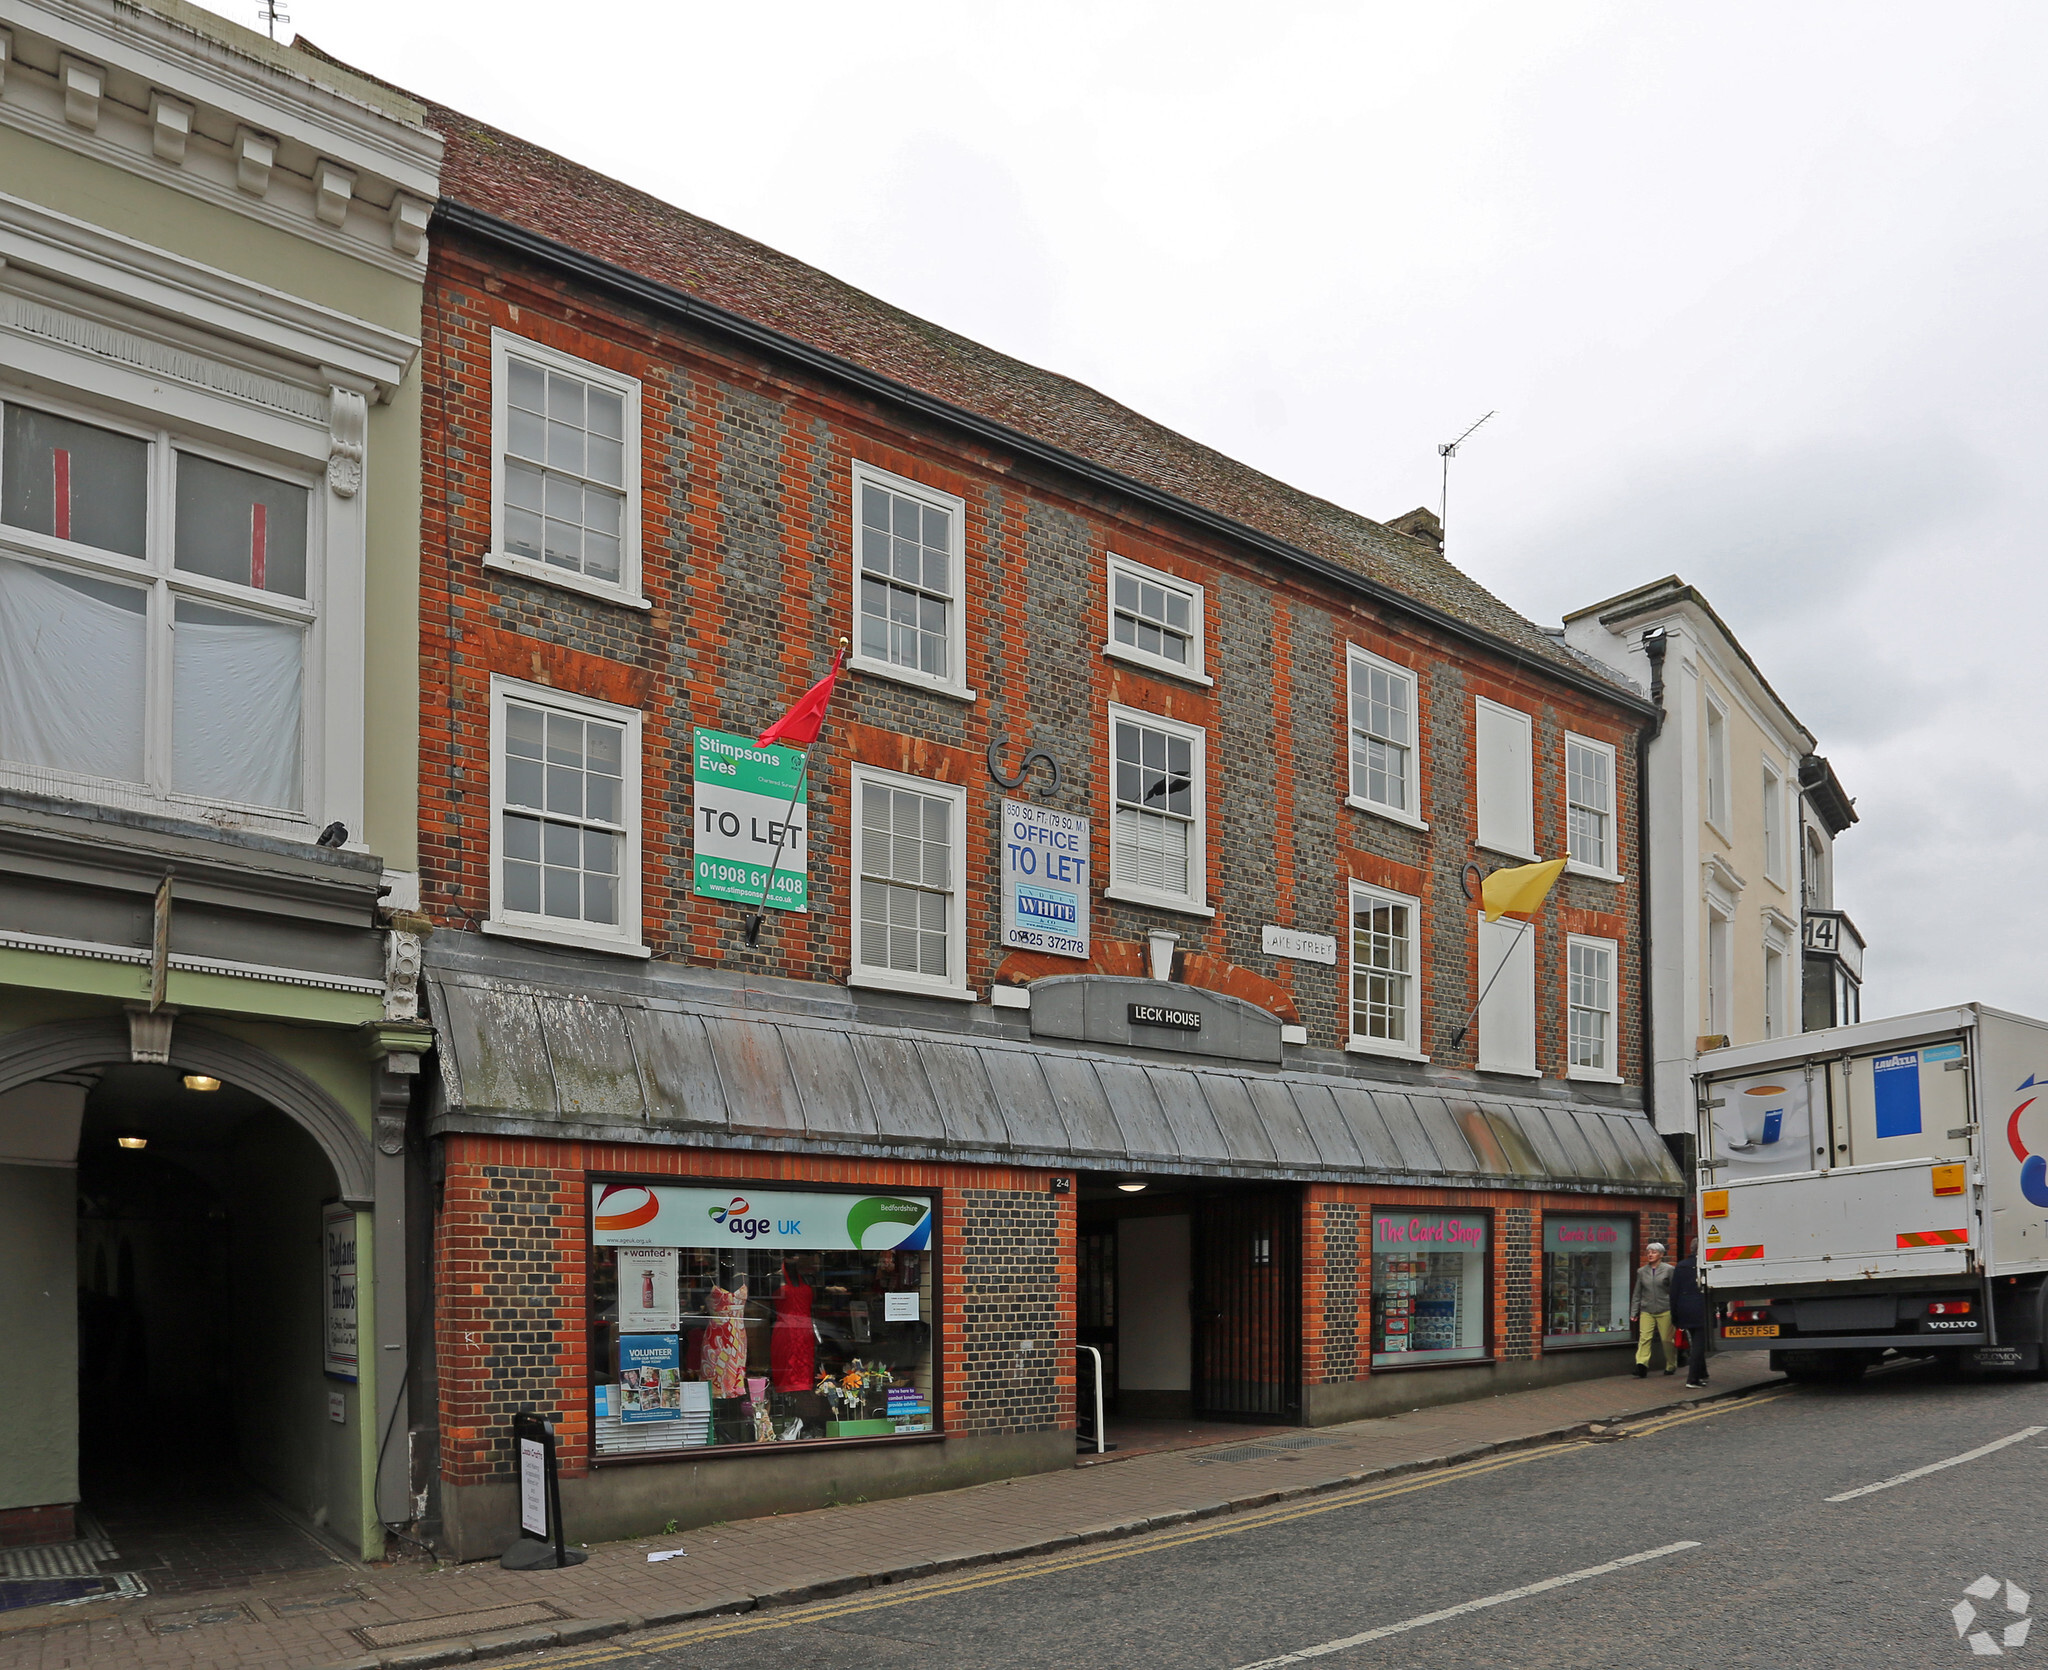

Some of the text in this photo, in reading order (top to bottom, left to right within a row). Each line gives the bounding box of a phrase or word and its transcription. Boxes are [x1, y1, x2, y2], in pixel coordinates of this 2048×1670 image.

[699, 735, 780, 767] Stimpsons
[699, 755, 737, 776] Eves
[1007, 803, 1020, 817] 850
[1022, 807, 1034, 821] SQ.
[699, 806, 802, 849] TO LET
[1013, 822, 1079, 852] OFFICE
[1008, 843, 1085, 884] TO LET
[699, 861, 803, 894] 01908 611408
[709, 883, 793, 904] www.stimpsonsees.co.uk
[1020, 897, 1074, 920] WHITE
[1048, 935, 1084, 953] 372178
[1266, 935, 1332, 955] AKE STREET
[1135, 1006, 1199, 1027] LECK HOUSE
[1874, 1055, 1917, 1069] LAVAZZA
[1056, 1178, 1069, 1188] 2-4
[880, 1203, 918, 1213] Bedfordshire
[729, 1217, 801, 1240] age UK
[1378, 1218, 1482, 1248] The Card Shop
[1558, 1225, 1618, 1243] Cards & Gifts
[630, 1248, 666, 1258] wanted
[1728, 1325, 1776, 1337] KR59 FSE
[1928, 1320, 1978, 1329] VOLVO
[629, 1348, 673, 1357] VOLUNTEER
